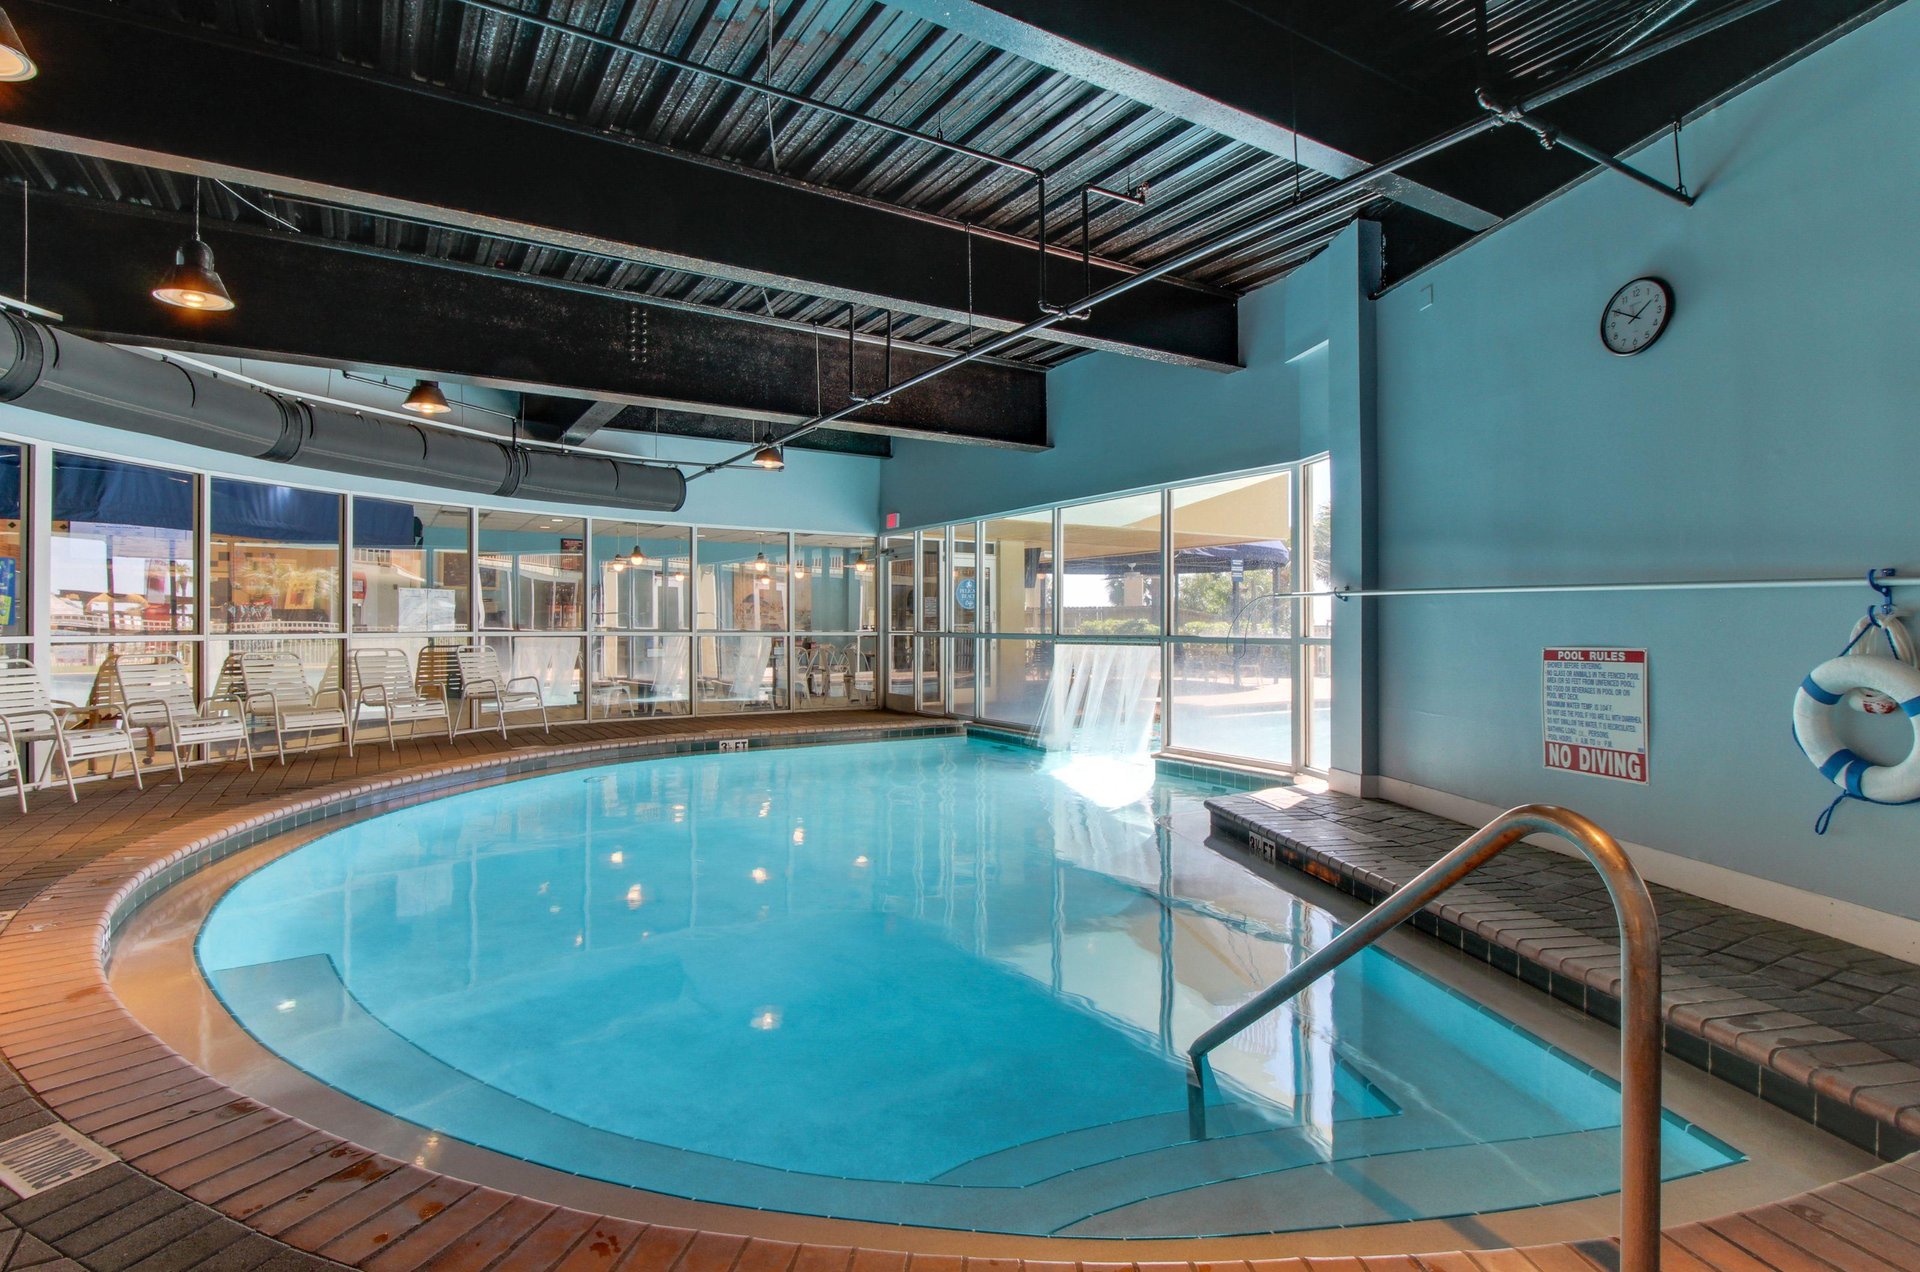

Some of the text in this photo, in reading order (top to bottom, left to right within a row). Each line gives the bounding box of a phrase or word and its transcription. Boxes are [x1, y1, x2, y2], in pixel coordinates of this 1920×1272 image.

[1633, 289, 1640, 297] 12
[1622, 296, 1628, 304] 11
[1558, 651, 1625, 661] POOL RULES
[1549, 744, 1641, 779] NO DIVING
[1263, 842, 1274, 857] FT
[0, 1127, 102, 1190] NO DIVING
